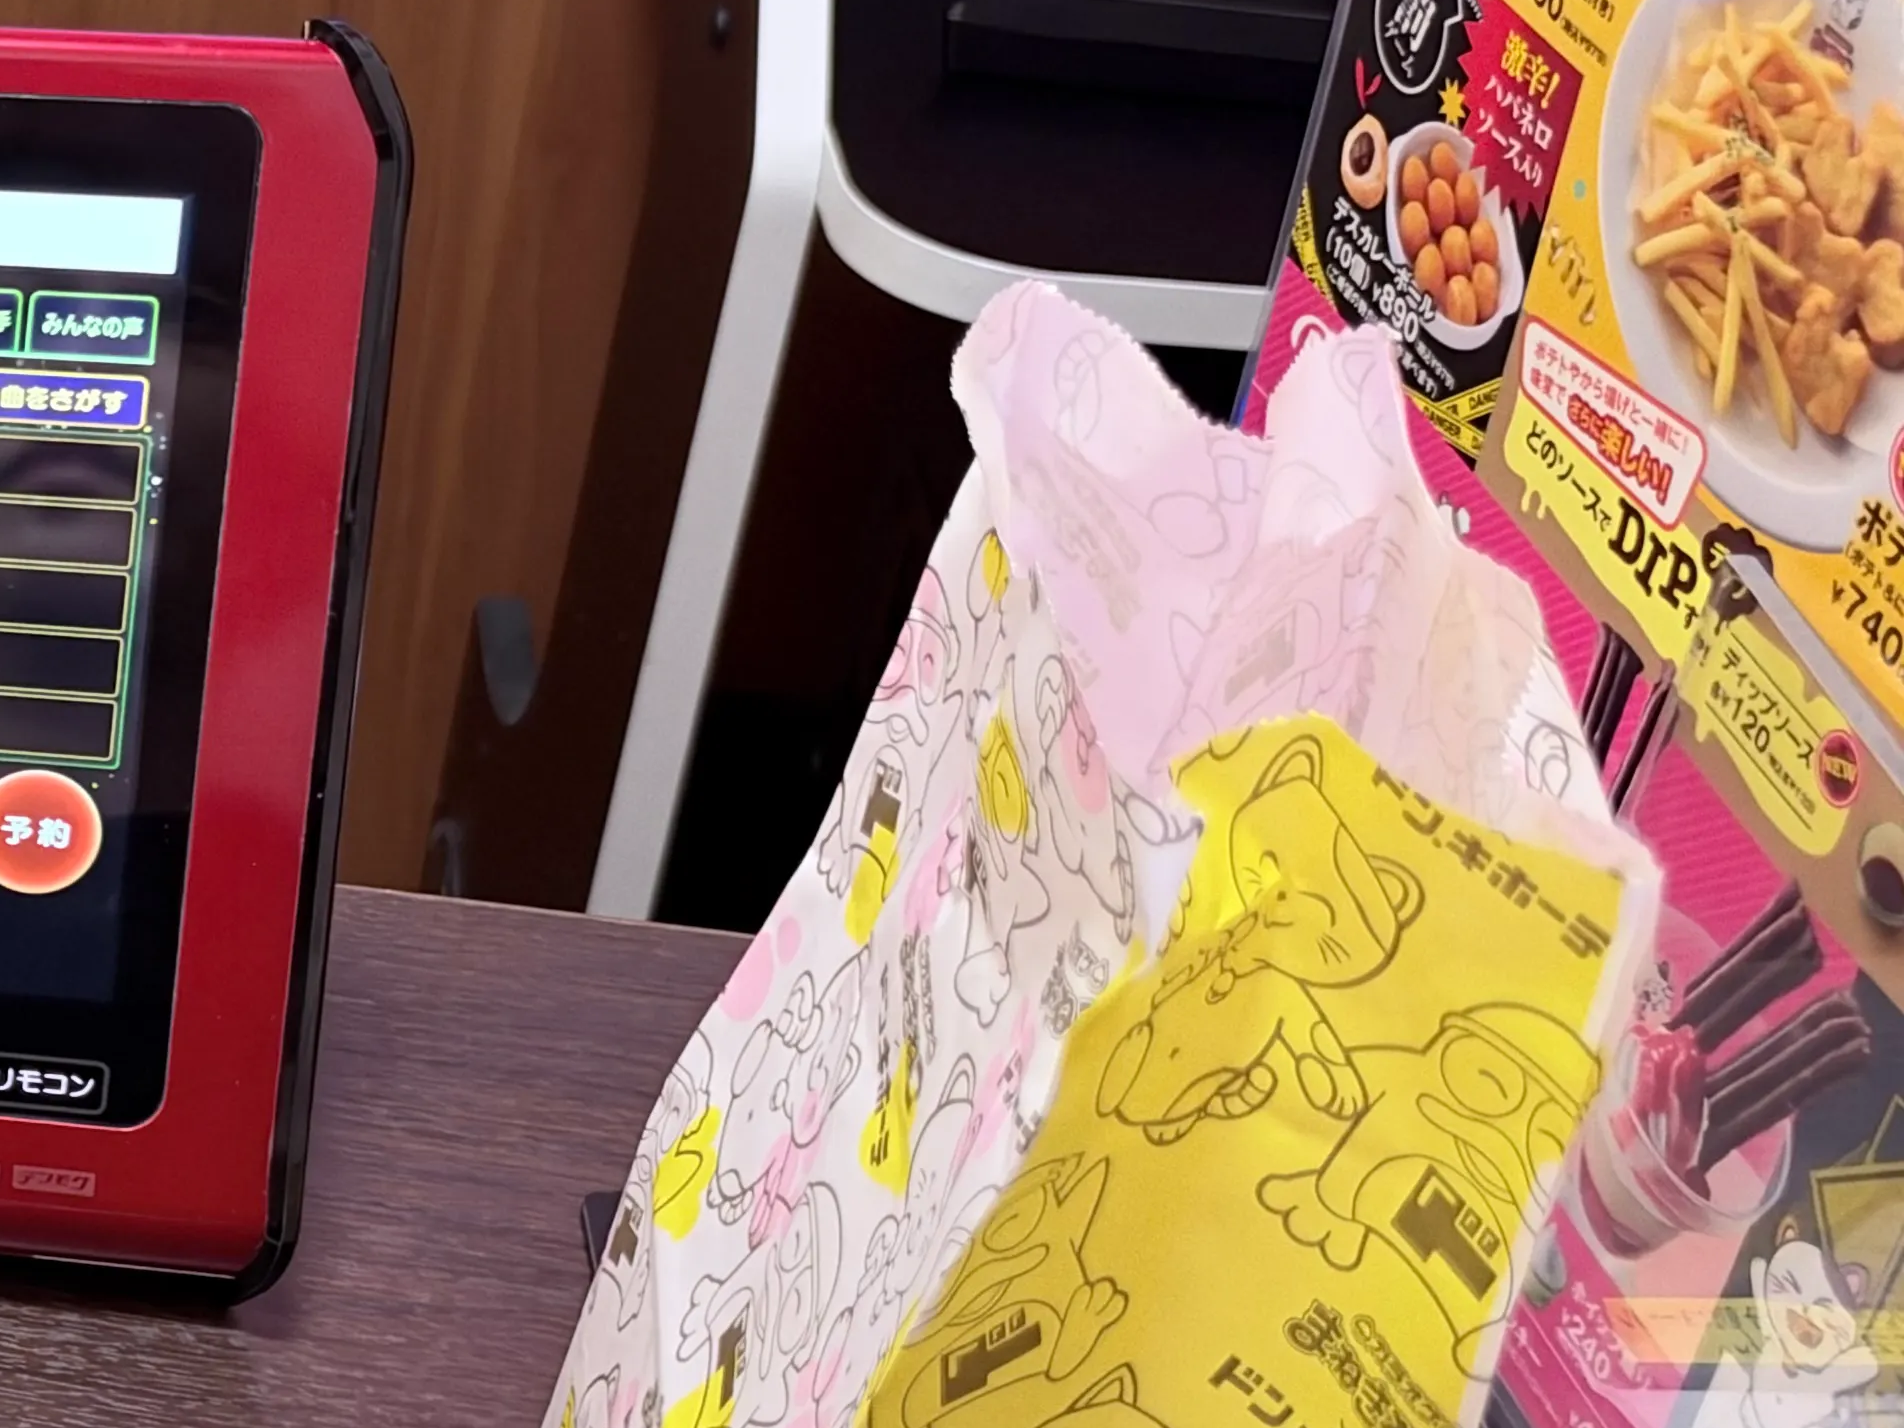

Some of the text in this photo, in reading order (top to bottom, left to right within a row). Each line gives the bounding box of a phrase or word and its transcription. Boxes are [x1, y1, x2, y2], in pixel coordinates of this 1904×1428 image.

[41, 312, 144, 341] みんなの声
[0, 817, 73, 850] 予約
